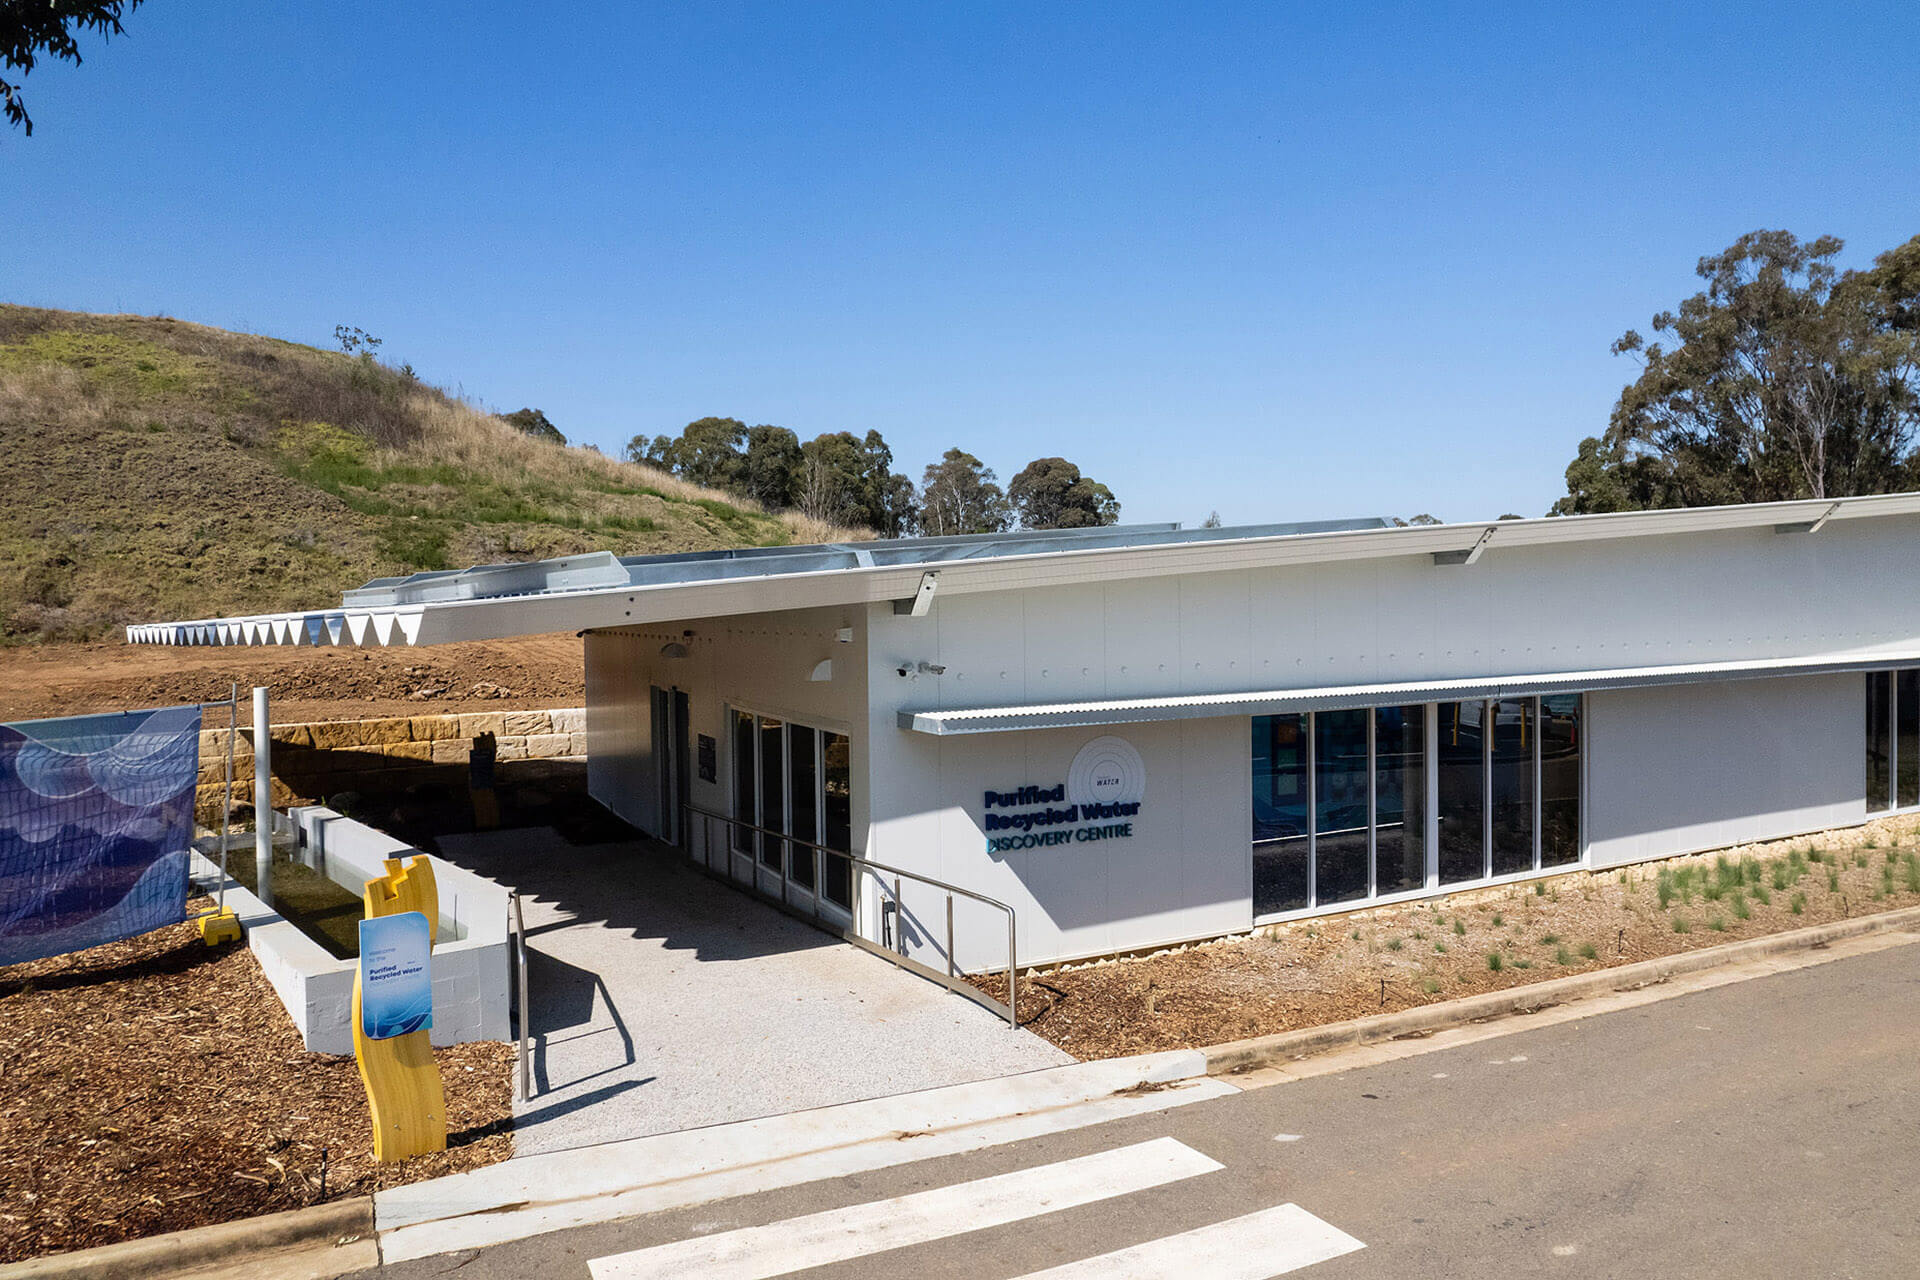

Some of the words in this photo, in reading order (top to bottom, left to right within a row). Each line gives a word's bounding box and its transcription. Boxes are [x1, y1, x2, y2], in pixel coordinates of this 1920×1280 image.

[1096, 778, 1119, 786] WATER
[984, 784, 1065, 808] Purified
[985, 805, 1078, 831] Recycled
[1080, 802, 1141, 820] Water
[986, 830, 1073, 853] DISCOVERY
[1075, 823, 1133, 842] CENTRE
[369, 965, 397, 975] Purified
[369, 970, 401, 981] Recycled
[402, 966, 423, 975] Water
